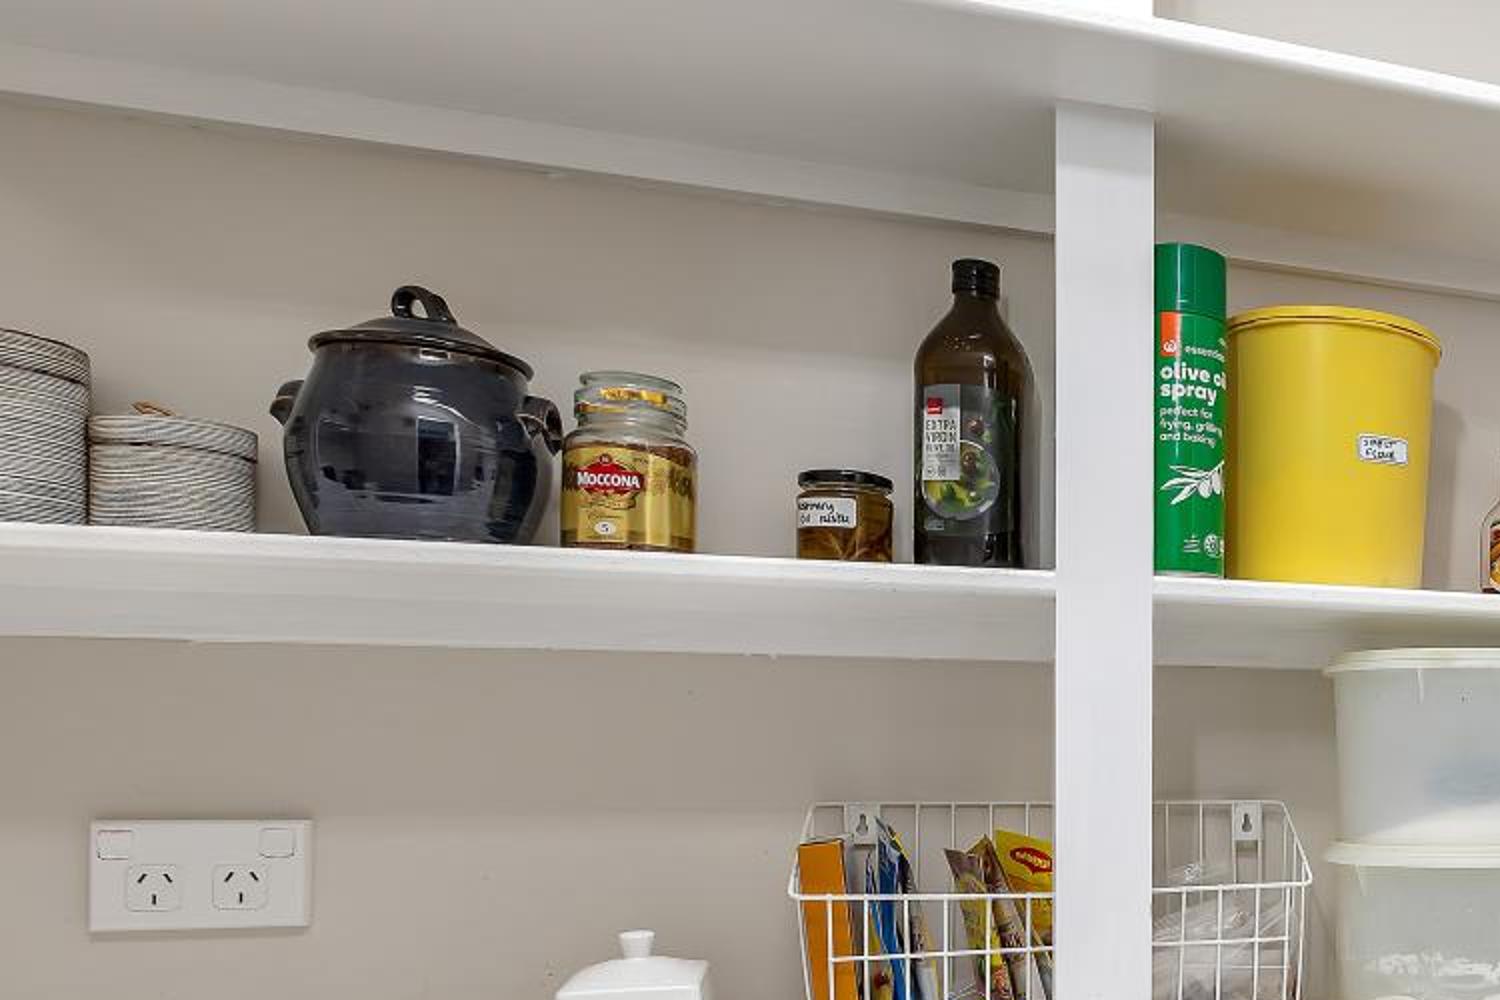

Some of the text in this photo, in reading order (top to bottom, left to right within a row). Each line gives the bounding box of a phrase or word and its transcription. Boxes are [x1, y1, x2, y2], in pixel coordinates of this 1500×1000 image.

[1160, 361, 1211, 383] olive
[1160, 383, 1217, 407] spray
[1160, 405, 1213, 420] perfect for
[1160, 432, 1181, 441] and
[576, 471, 641, 490] MOCCONA
